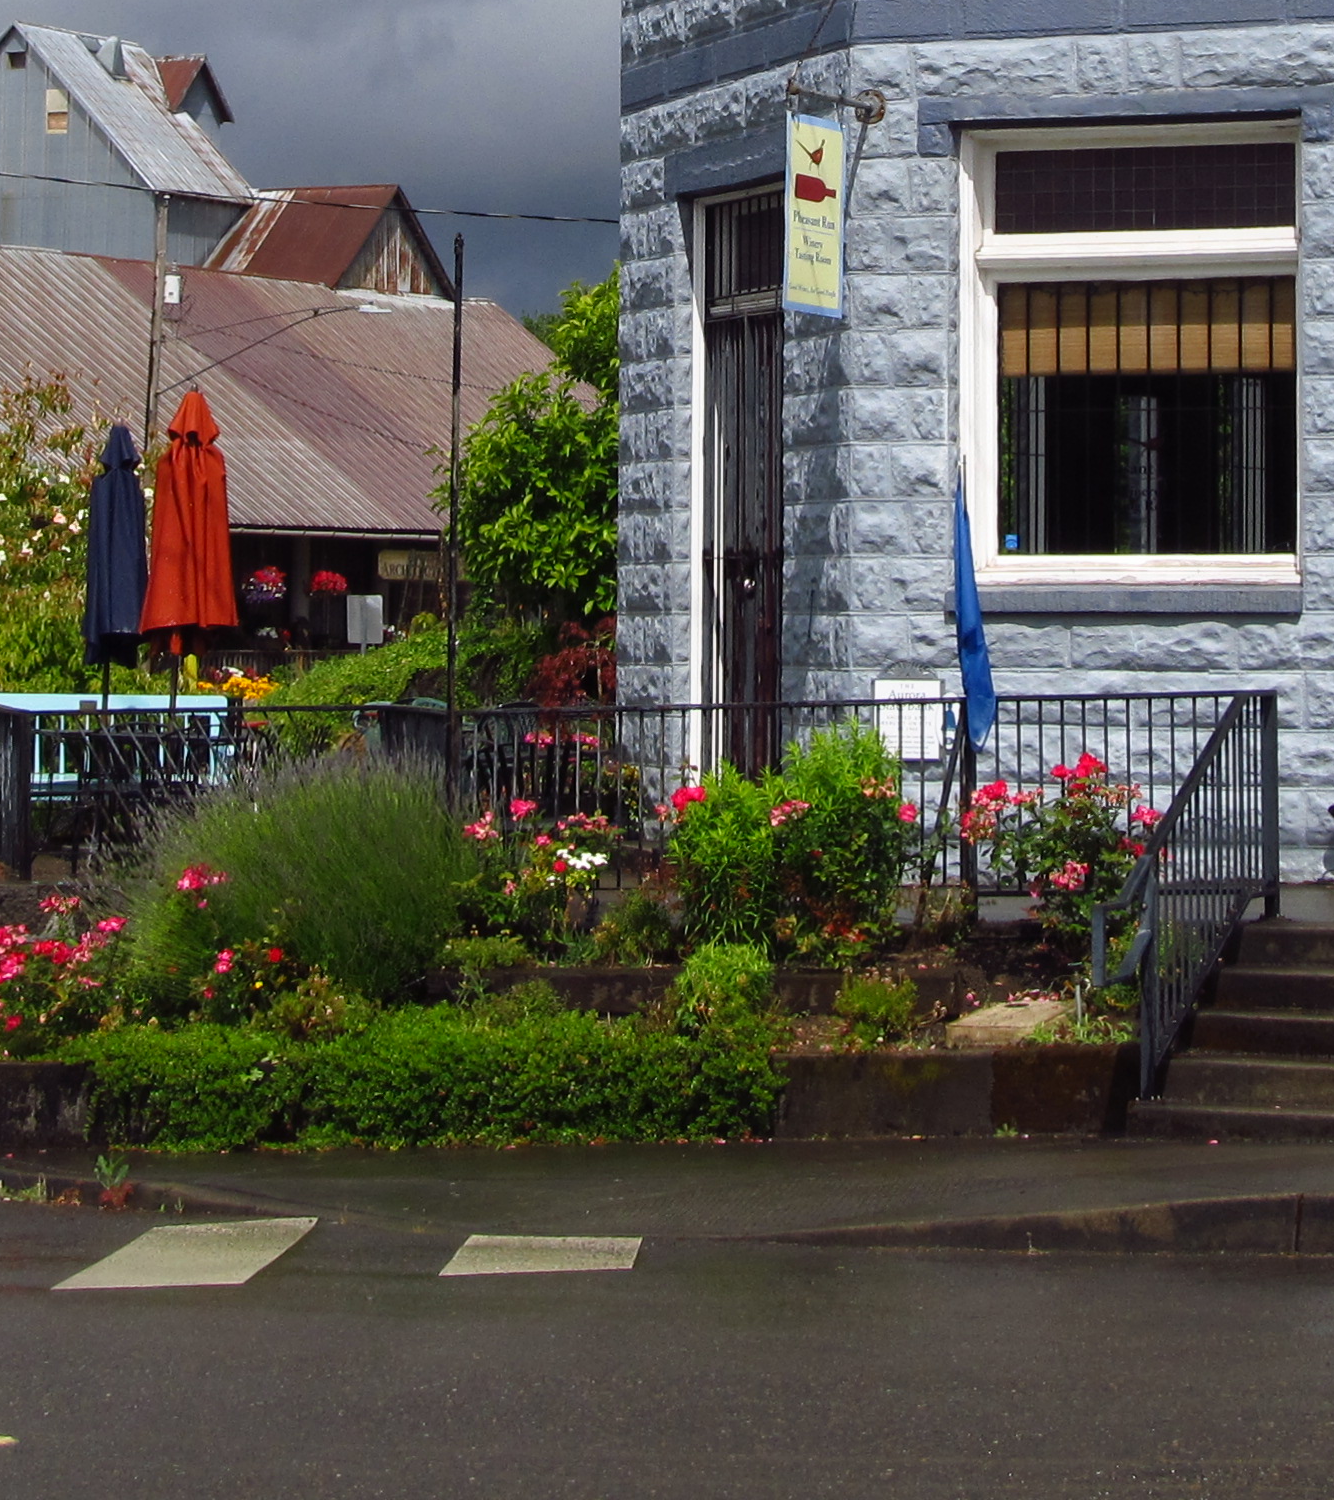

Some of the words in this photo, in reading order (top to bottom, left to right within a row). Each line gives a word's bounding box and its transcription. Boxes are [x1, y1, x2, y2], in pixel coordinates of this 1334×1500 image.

[793, 209, 821, 227] Pheasant
[822, 215, 835, 230] Run
[802, 235, 823, 252] Winery
[795, 247, 815, 266] Tasting
[815, 252, 832, 265] Room
[888, 689, 926, 699] Aurora
